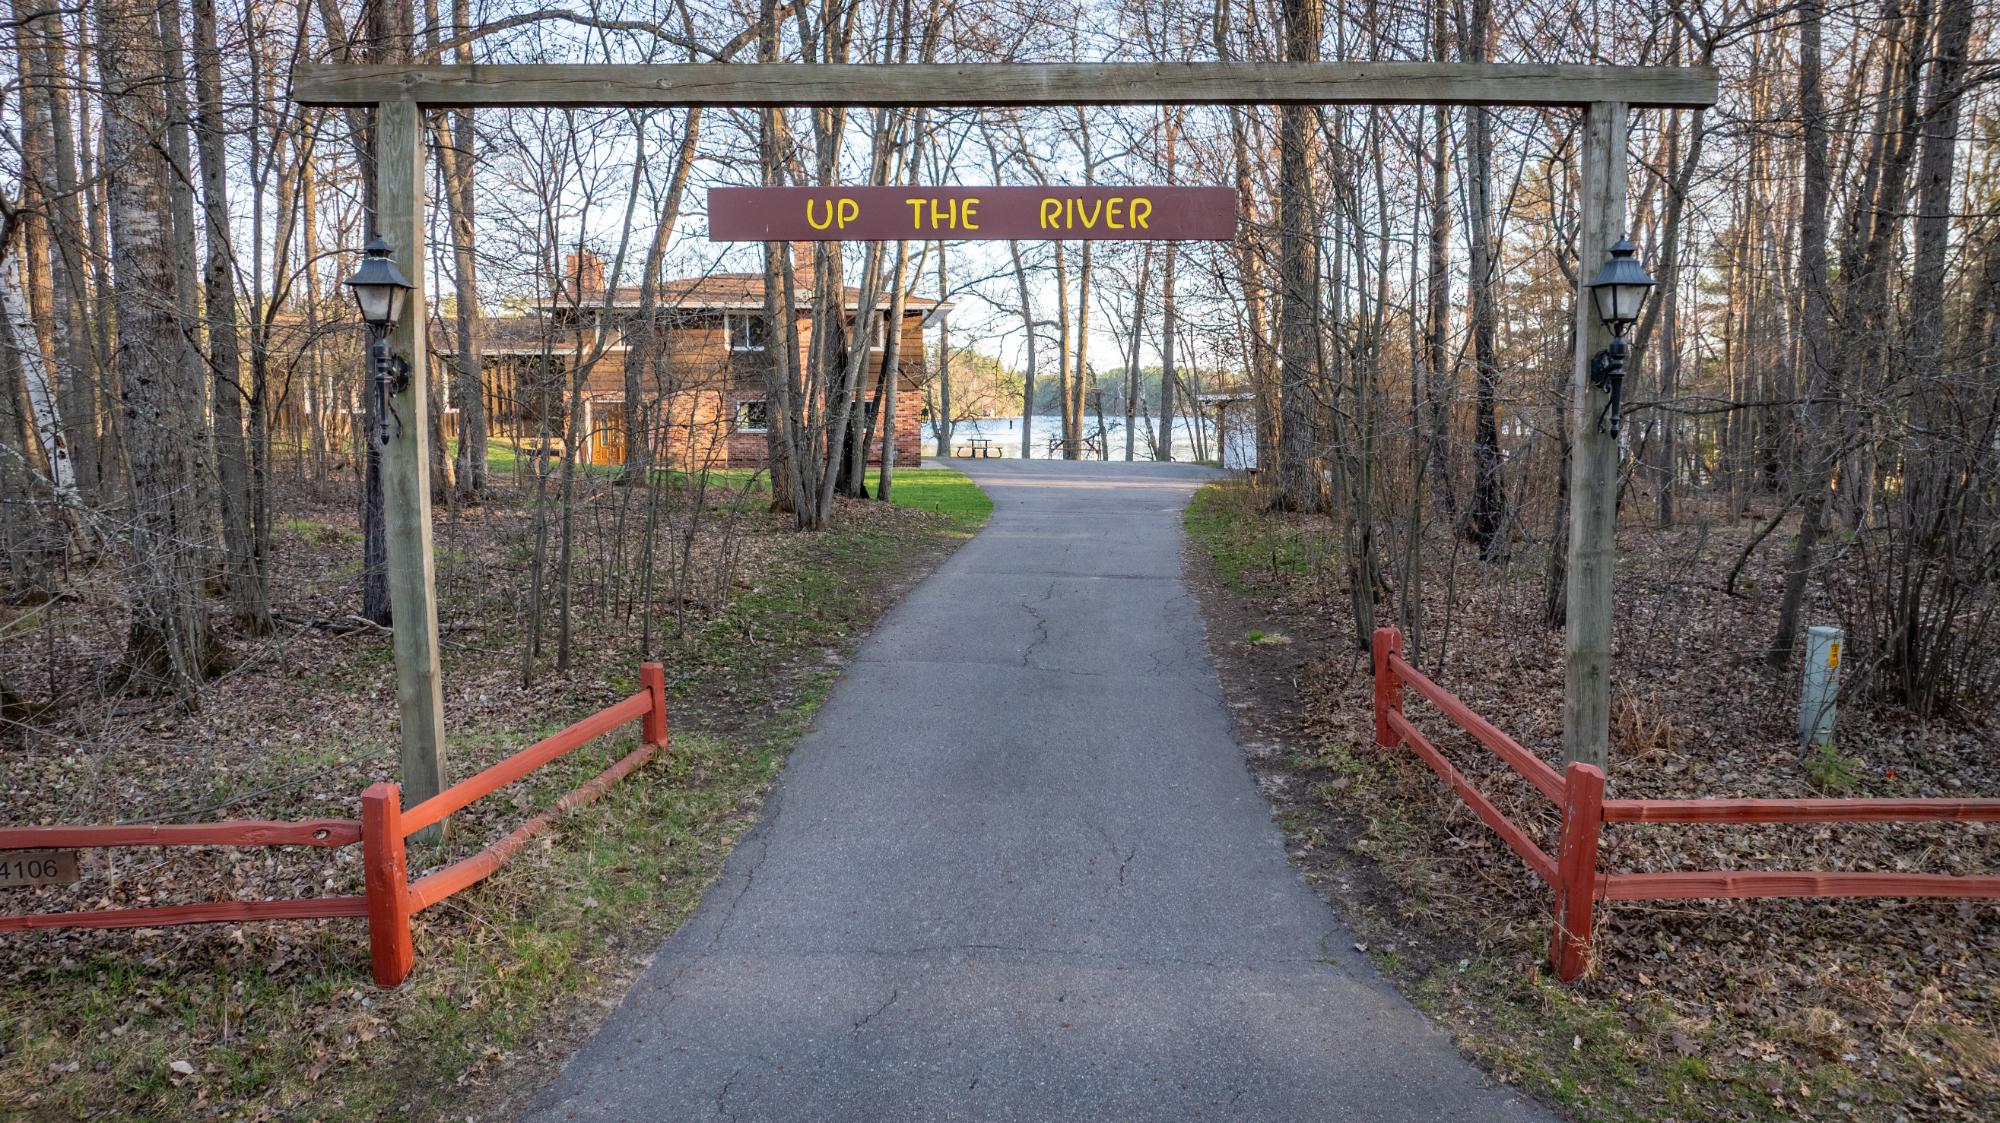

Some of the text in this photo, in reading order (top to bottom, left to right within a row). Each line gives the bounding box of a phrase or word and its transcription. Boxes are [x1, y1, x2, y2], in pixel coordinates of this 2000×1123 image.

[806, 197, 1152, 230] UP THE RIVER
[0, 859, 58, 880] 4106
